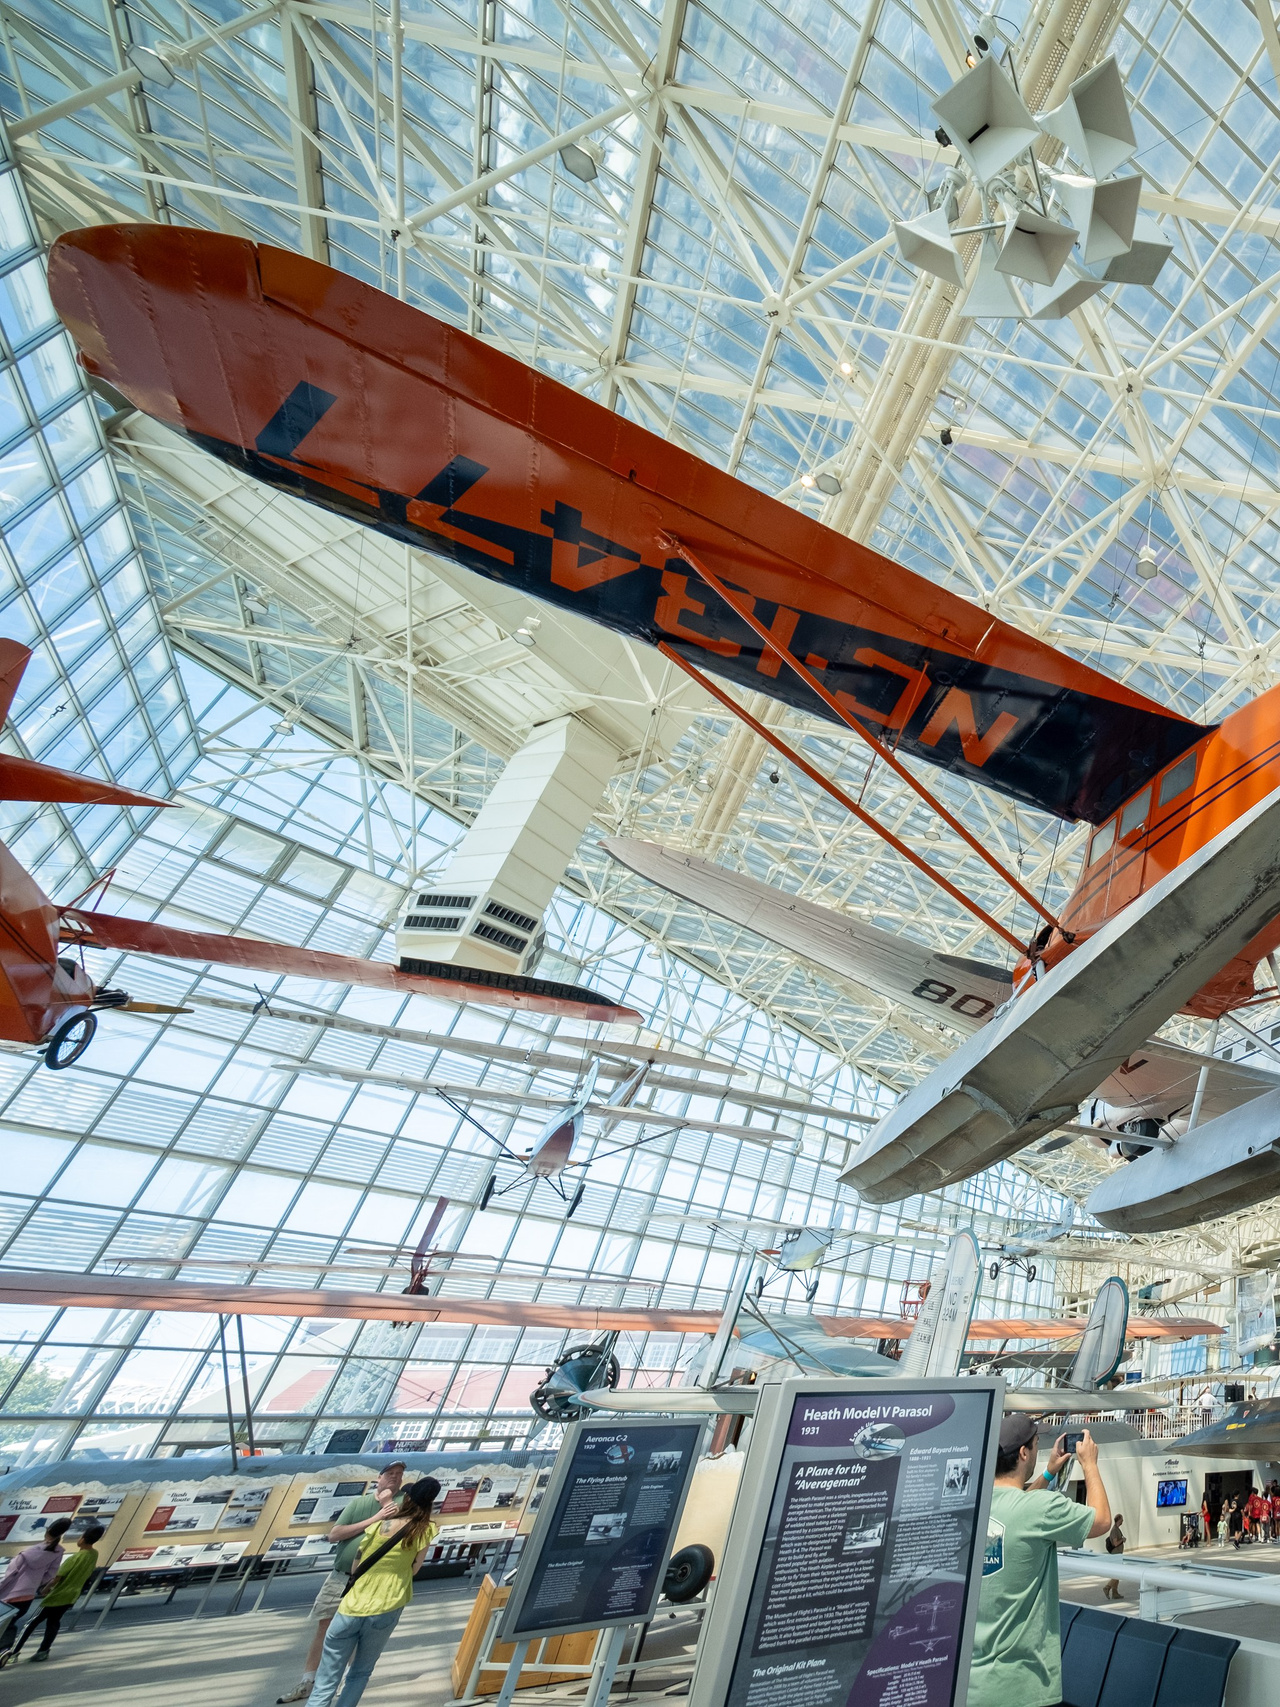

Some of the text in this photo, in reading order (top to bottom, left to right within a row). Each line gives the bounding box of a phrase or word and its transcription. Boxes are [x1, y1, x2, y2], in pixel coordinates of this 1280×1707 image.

[803, 1405, 933, 1422] Heath Model V Parasol
[801, 1426, 820, 1436] 1931
[585, 1435, 615, 1443] Aeronca
[796, 1464, 867, 1478] A Plane for the
[605, 1475, 628, 1483] Bathtub
[752, 1659, 826, 1678] The Original Kit Plane
